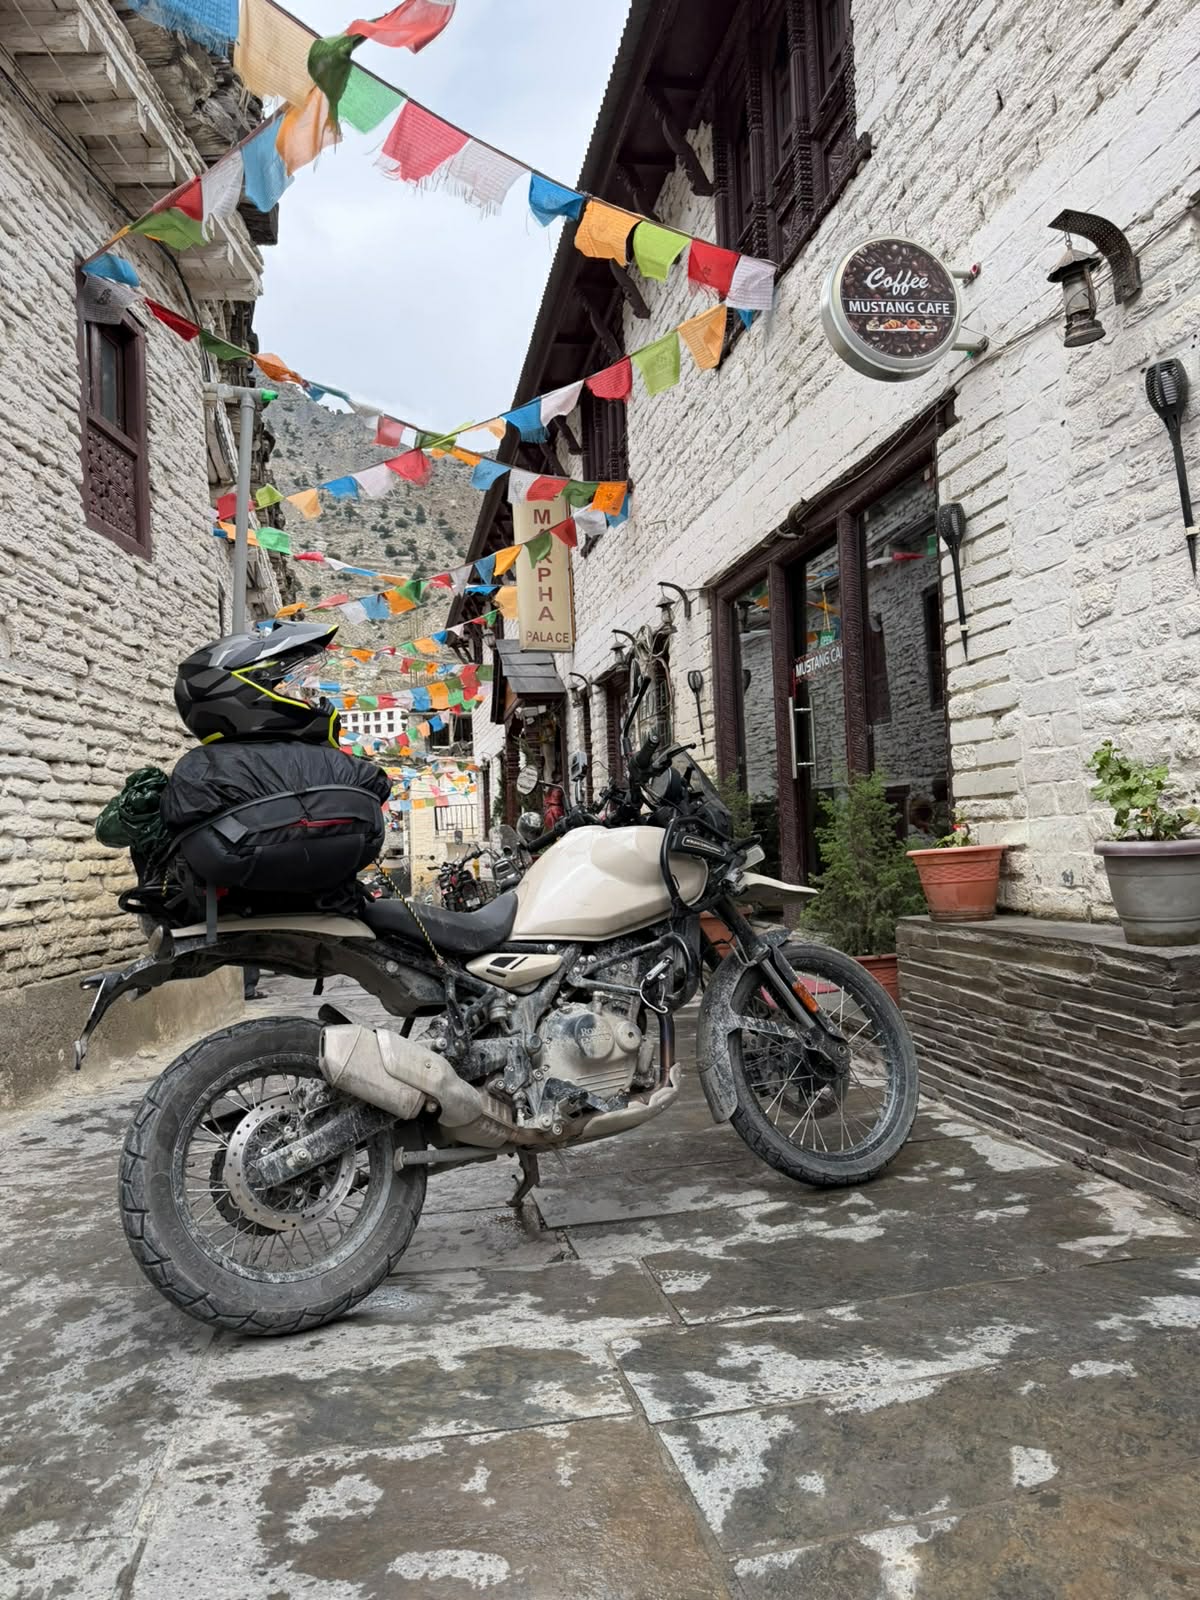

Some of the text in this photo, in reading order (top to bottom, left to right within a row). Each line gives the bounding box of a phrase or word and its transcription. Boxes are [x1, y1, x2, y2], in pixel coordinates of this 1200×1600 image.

[865, 266, 930, 296] Coffee
[849, 300, 950, 315] MUSTANG CAFE
[533, 508, 555, 622] MPHA
[526, 631, 569, 644] PALACE
[795, 646, 843, 678] MUSTANG CA
